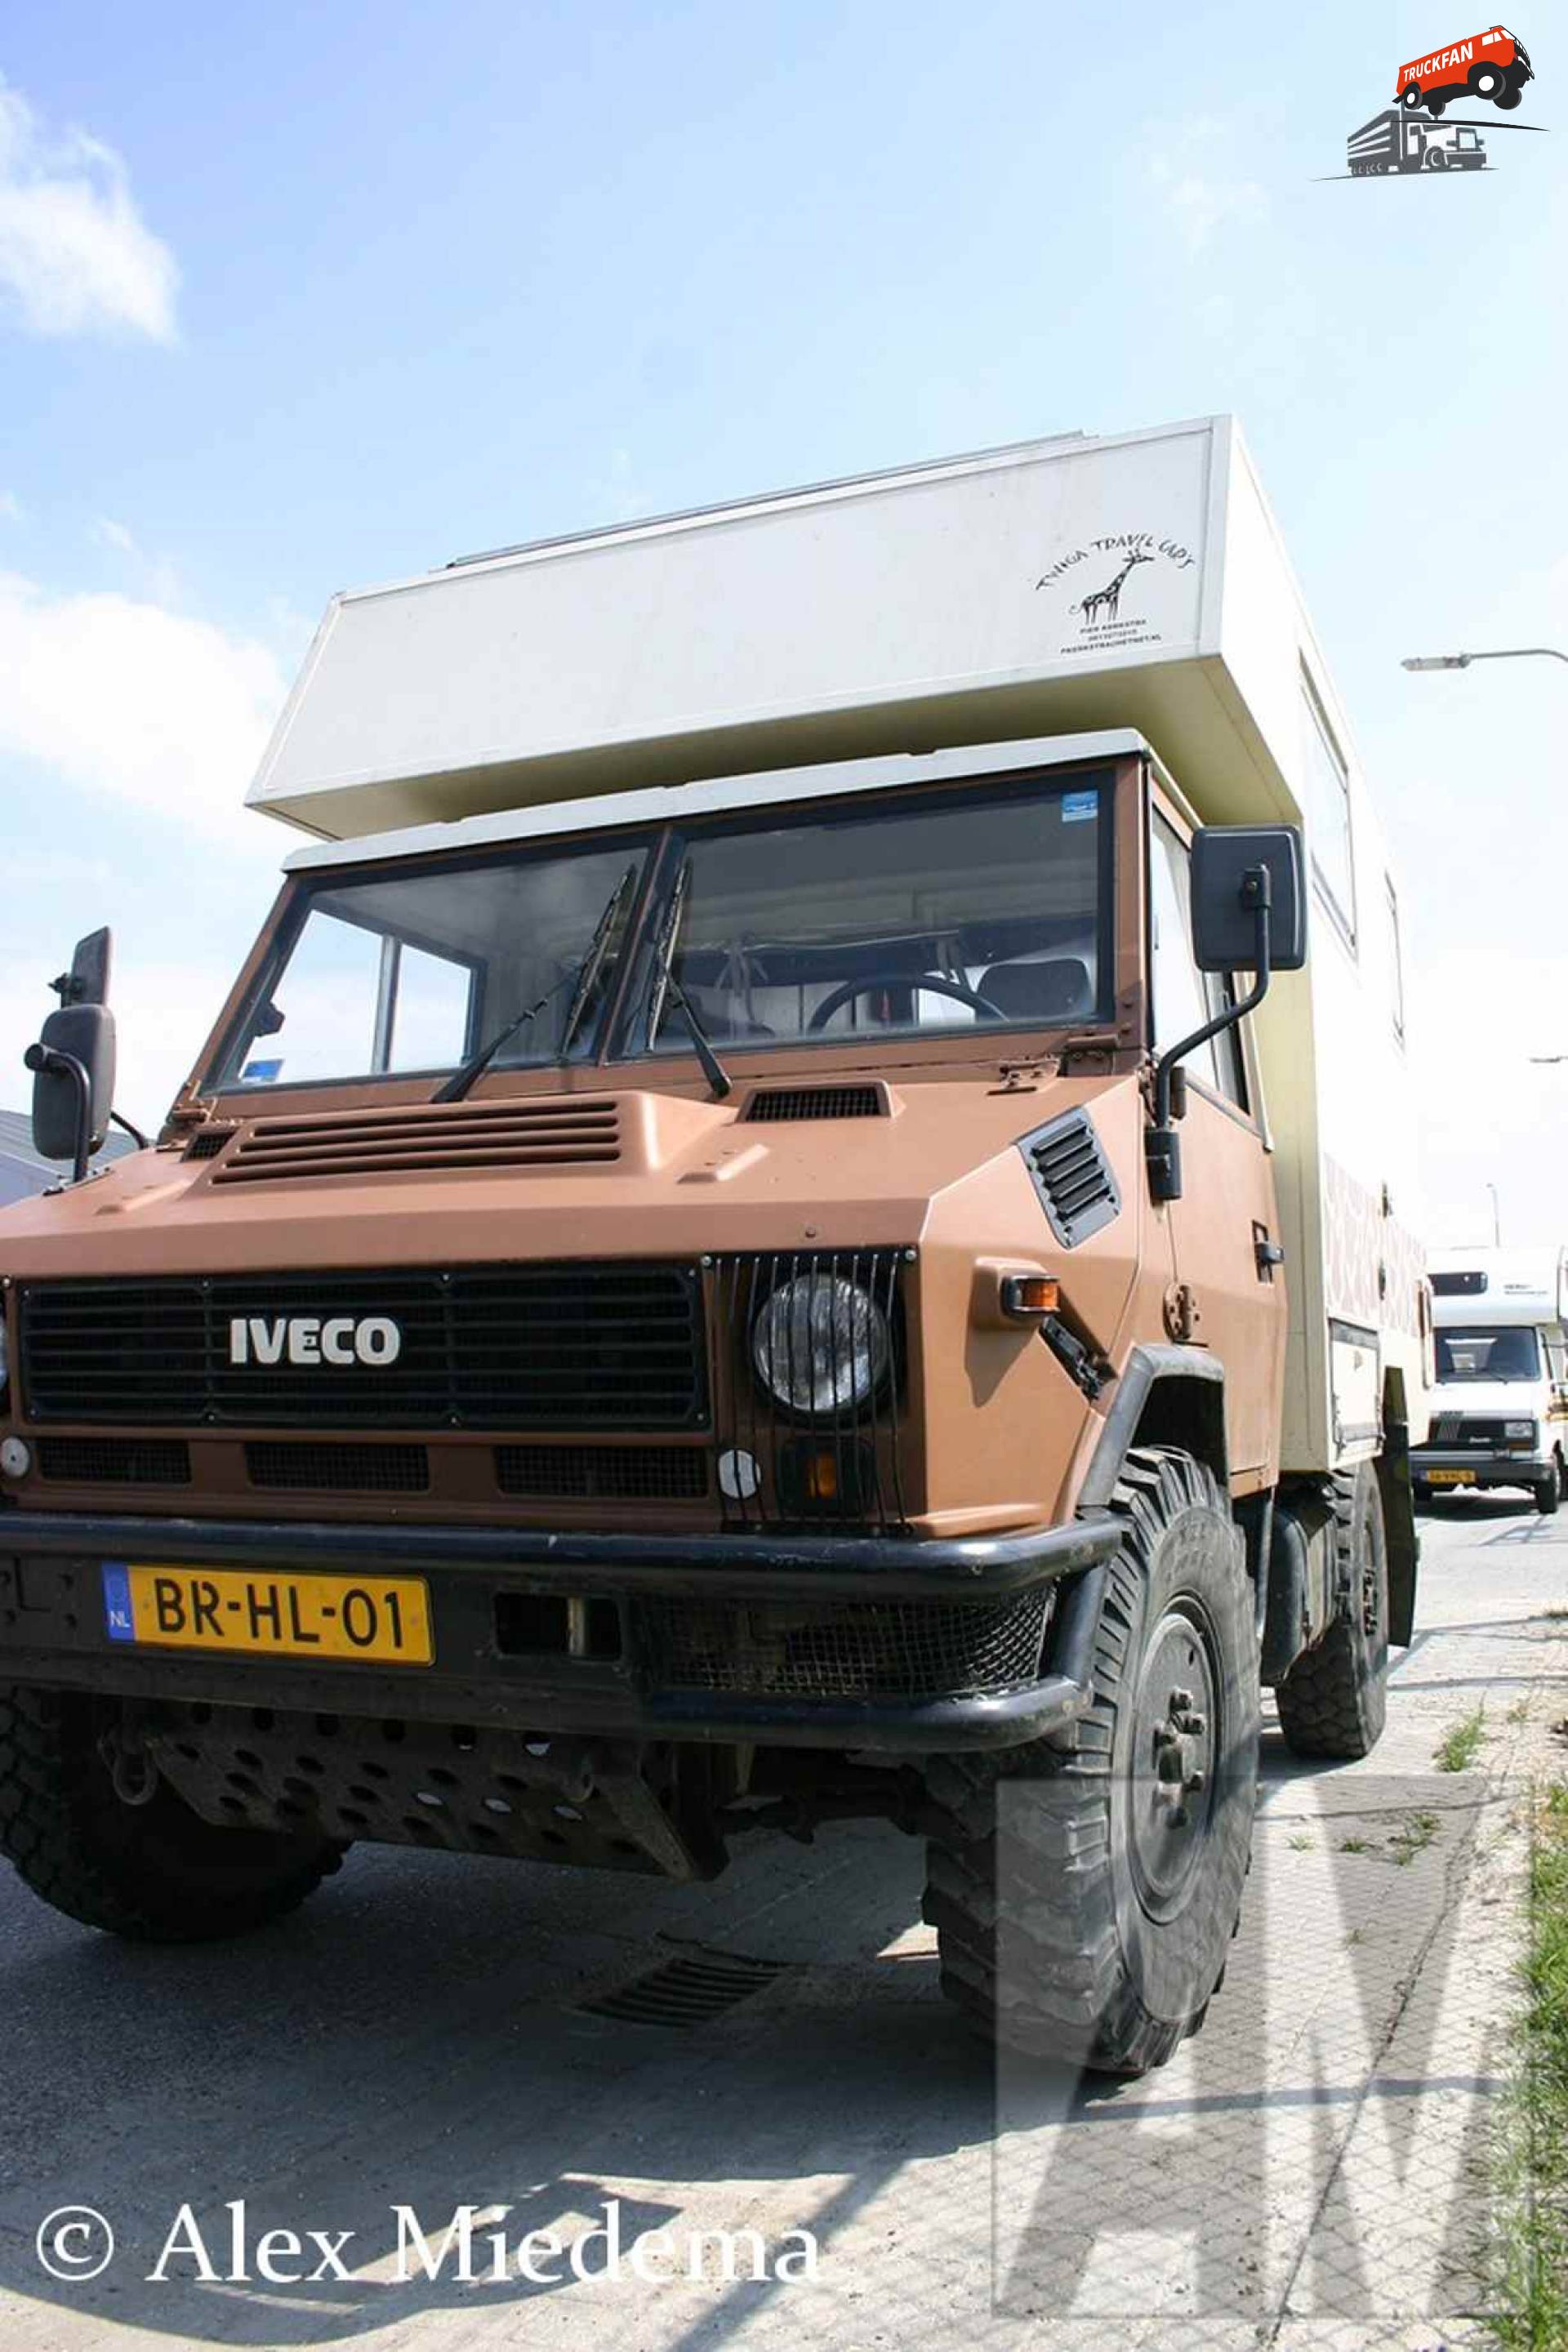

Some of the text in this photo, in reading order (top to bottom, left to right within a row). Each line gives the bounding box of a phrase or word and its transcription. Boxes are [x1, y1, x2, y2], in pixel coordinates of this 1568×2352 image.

[1090, 533, 1153, 550] TRAVEL
[229, 1317, 400, 1365] IVECO
[109, 1579, 403, 1649] NL BR-HL-01
